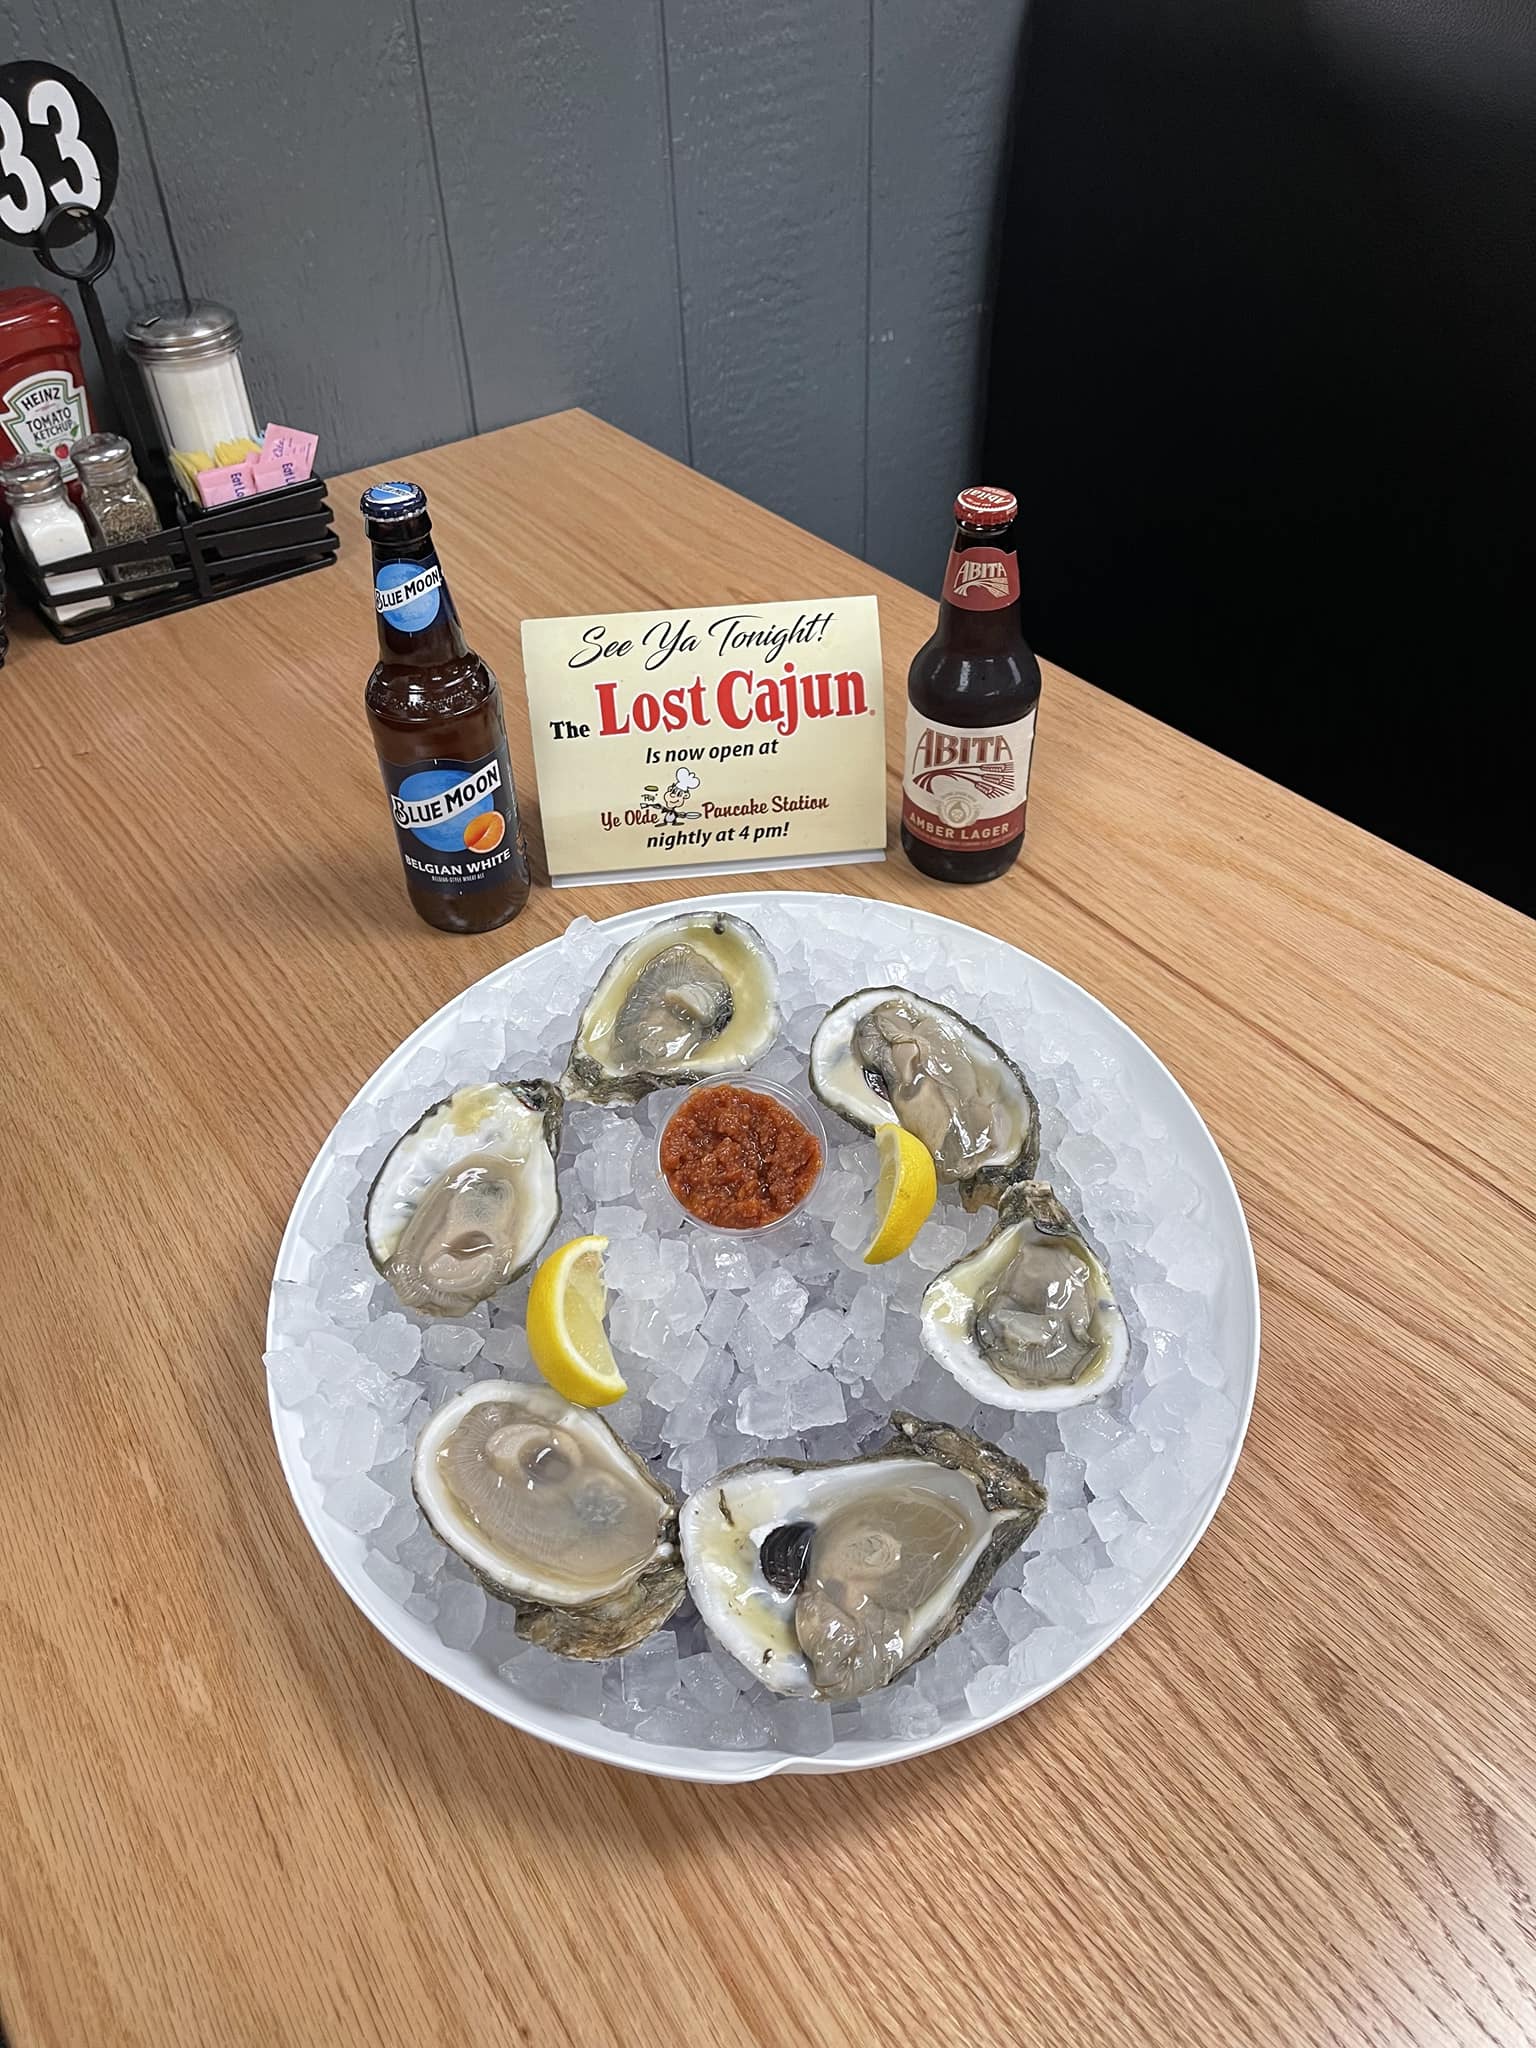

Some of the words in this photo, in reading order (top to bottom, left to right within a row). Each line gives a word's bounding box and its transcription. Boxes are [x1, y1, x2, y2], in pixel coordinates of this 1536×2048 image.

[0, 80, 101, 234] 33
[21, 387, 61, 411] HEINZ
[26, 407, 72, 433] TOMATO
[33, 420, 74, 441] KETCHUP
[230, 472, 242, 487] Eat
[953, 560, 1007, 588] ABITA
[376, 590, 403, 611] BLUE
[404, 569, 440, 600] MOON
[568, 626, 634, 668] See
[642, 620, 701, 670] Ya
[709, 612, 840, 664] Tonight!
[550, 720, 590, 739] The
[595, 676, 711, 736] Lost
[717, 663, 868, 736] Cajun
[646, 748, 660, 763] Is
[665, 749, 704, 762] now
[709, 743, 754, 762] open
[759, 739, 779, 754] at
[912, 728, 1013, 775] ABITA
[393, 798, 443, 825] BLUE
[444, 765, 498, 814] MOON
[601, 812, 621, 831] Ye
[625, 810, 658, 826] Olde
[702, 798, 768, 819] Pancake
[772, 795, 829, 811] Station
[910, 812, 954, 839] AMBER
[961, 822, 1009, 840] LAGER
[647, 829, 711, 850] nightly
[716, 827, 735, 841] at
[740, 826, 750, 839] 4
[753, 822, 790, 842] pm!
[404, 854, 462, 875] BELGIAN
[466, 848, 512, 874] WHITE
